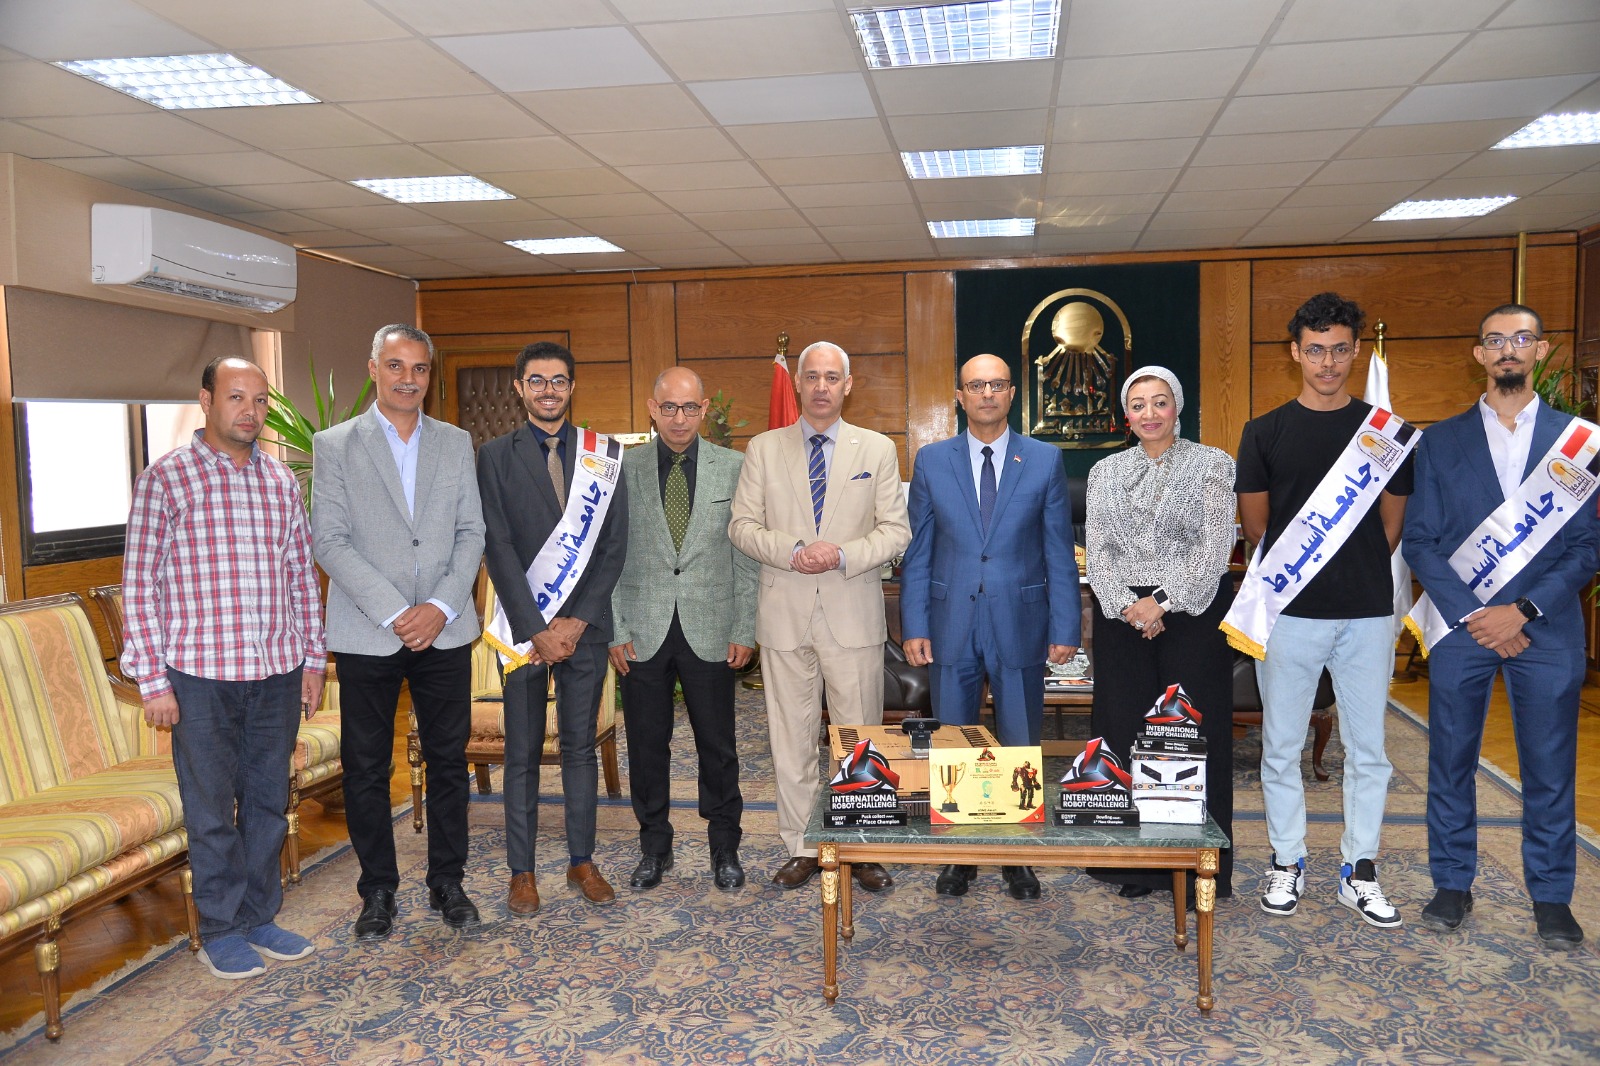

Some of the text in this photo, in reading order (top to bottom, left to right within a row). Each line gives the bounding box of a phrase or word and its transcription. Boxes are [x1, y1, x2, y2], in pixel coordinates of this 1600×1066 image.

[559, 480, 608, 549] جامعة
[1262, 461, 1380, 593] جامعة أسيوط
[1467, 490, 1564, 591] جامعة أسي
[1145, 725, 1199, 734] INTERNATIONAL
[1165, 731, 1199, 739] CHALLENGE
[831, 793, 897, 803] INTERNATIONAL
[1062, 793, 1129, 802] INTERNATIONAL
[831, 801, 897, 810] ROBOT CHALLENGE
